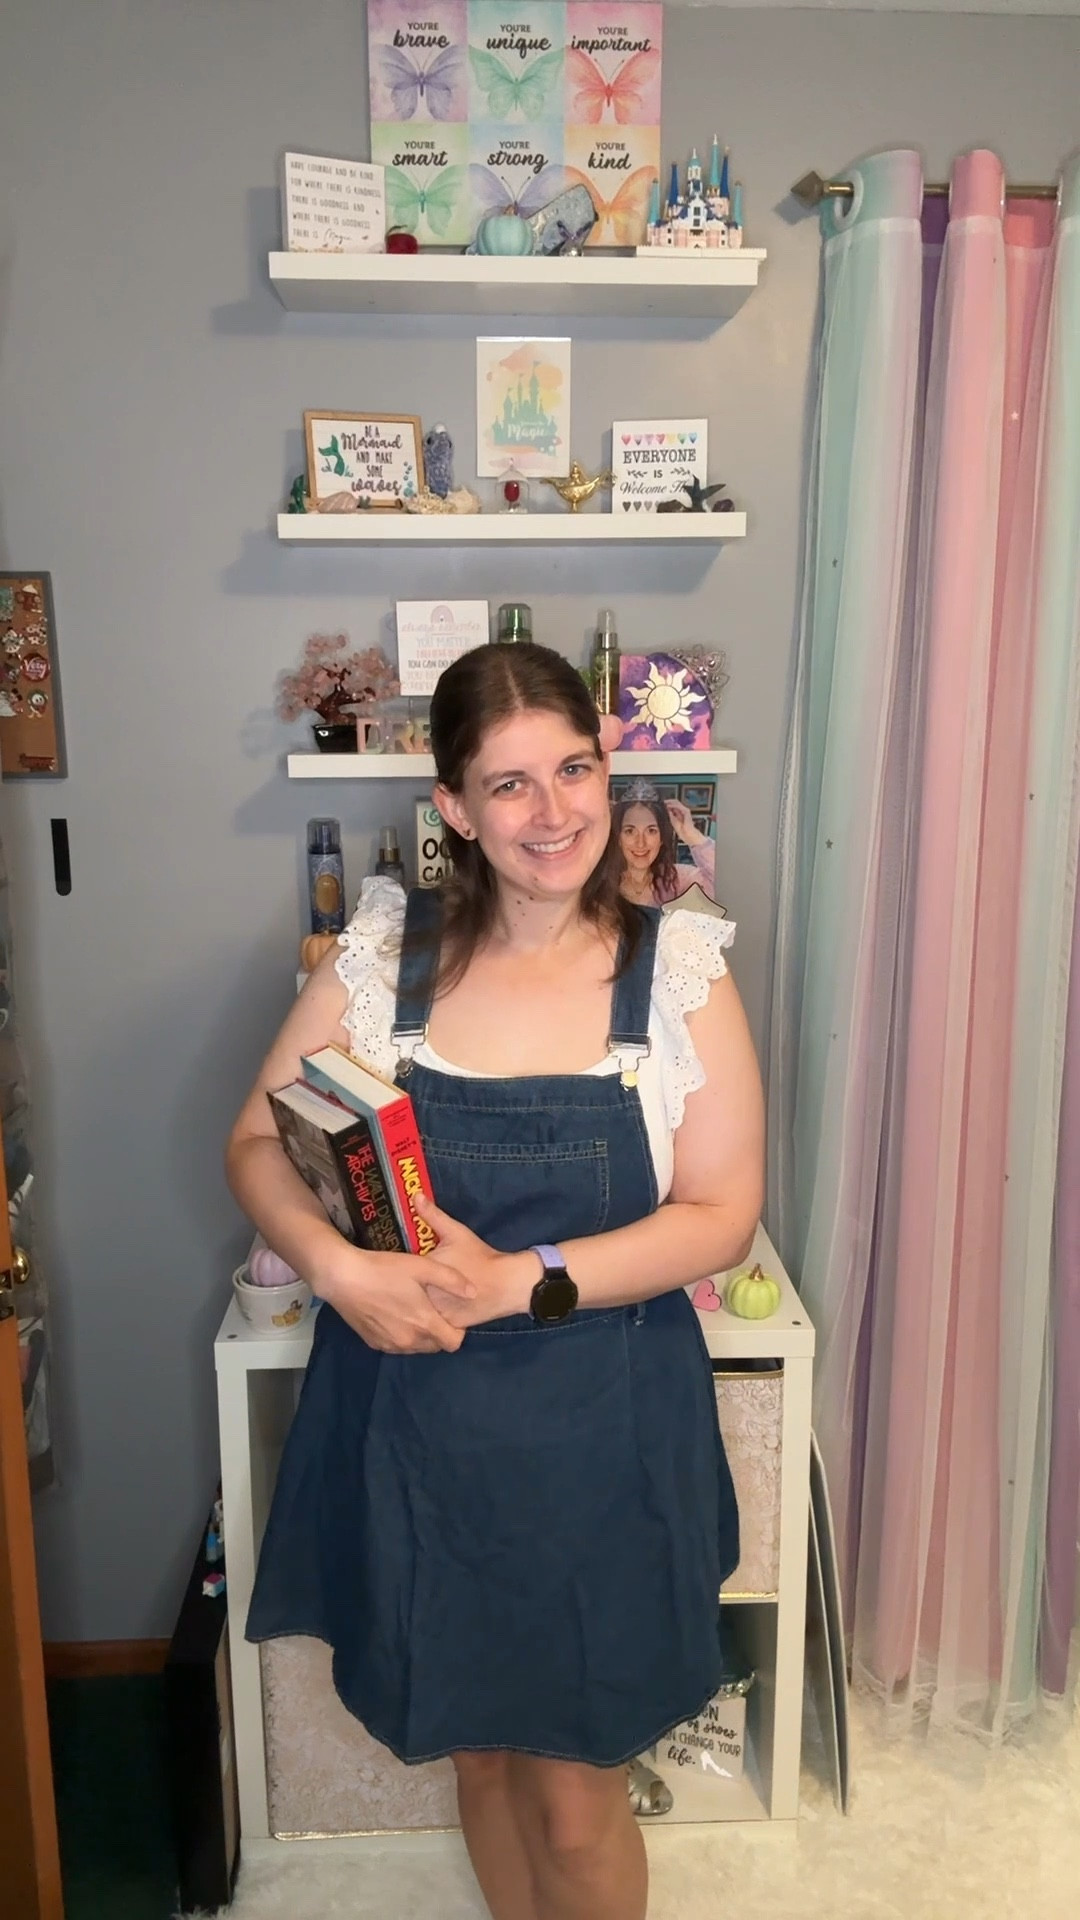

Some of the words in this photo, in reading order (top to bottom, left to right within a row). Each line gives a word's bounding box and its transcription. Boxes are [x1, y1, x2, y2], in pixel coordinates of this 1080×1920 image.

[407, 22, 439, 31] YOU'RE
[500, 24, 531, 33] YOU'RE
[597, 27, 628, 36] YOU'RE
[393, 30, 450, 49] brave
[486, 34, 551, 59] unique
[571, 35, 651, 52] important
[404, 141, 435, 150] YOU'RE
[499, 141, 530, 150] YOU'RE
[596, 142, 626, 151] YOU'RE
[392, 150, 448, 166] smart
[487, 151, 548, 174] strong
[588, 152, 631, 170] kind
[336, 167, 347, 177] AND
[354, 187, 381, 198] KINDNESS
[353, 203, 365, 213] AND
[365, 425, 372, 438] BE
[375, 426, 380, 438] A
[341, 432, 403, 450] Mermaid
[356, 451, 370, 464] AND
[375, 451, 393, 464] MAKE
[623, 449, 697, 464] EVERYONE
[366, 465, 383, 478] SOME
[654, 469, 663, 478] IS
[351, 478, 401, 496] waves
[620, 481, 667, 495] Welcome
[357, 1142, 375, 1168] THE
[344, 1153, 377, 1222] ARCHIVES
[365, 1167, 386, 1203] WALT
[397, 1156, 423, 1213] MICK
[412, 1215, 438, 1256] MOUS
[376, 1204, 400, 1252] DISNEY
[703, 1721, 738, 1739] shoes
[667, 1745, 695, 1766] life.
[717, 1741, 741, 1757] YOUR
